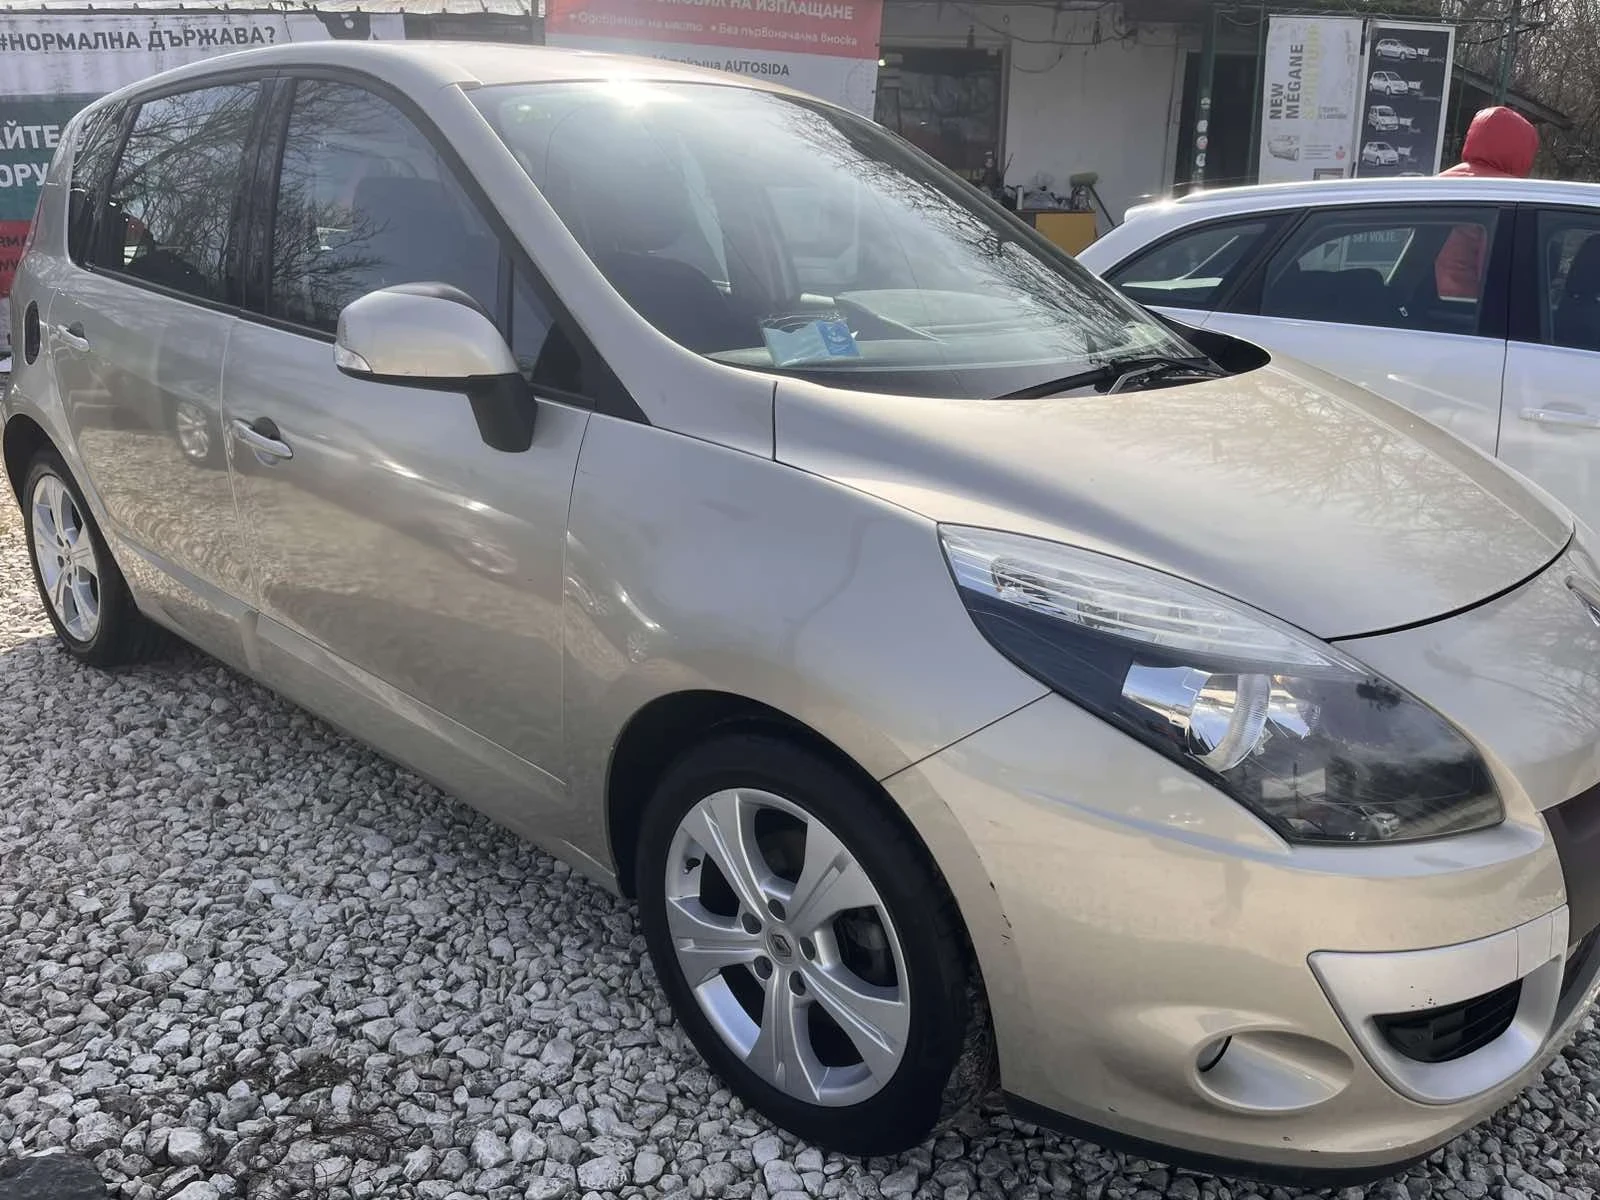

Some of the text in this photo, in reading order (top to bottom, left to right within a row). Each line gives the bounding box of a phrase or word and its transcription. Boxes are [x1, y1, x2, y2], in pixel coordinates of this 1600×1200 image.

[755, 0, 854, 20] ИЗПЛАЩАНЕ
[0, 26, 276, 51] #НОРМАЛНА ДЪРЖАВА?
[724, 59, 790, 76] AUTOSIDA
[1269, 83, 1284, 119] NEW
